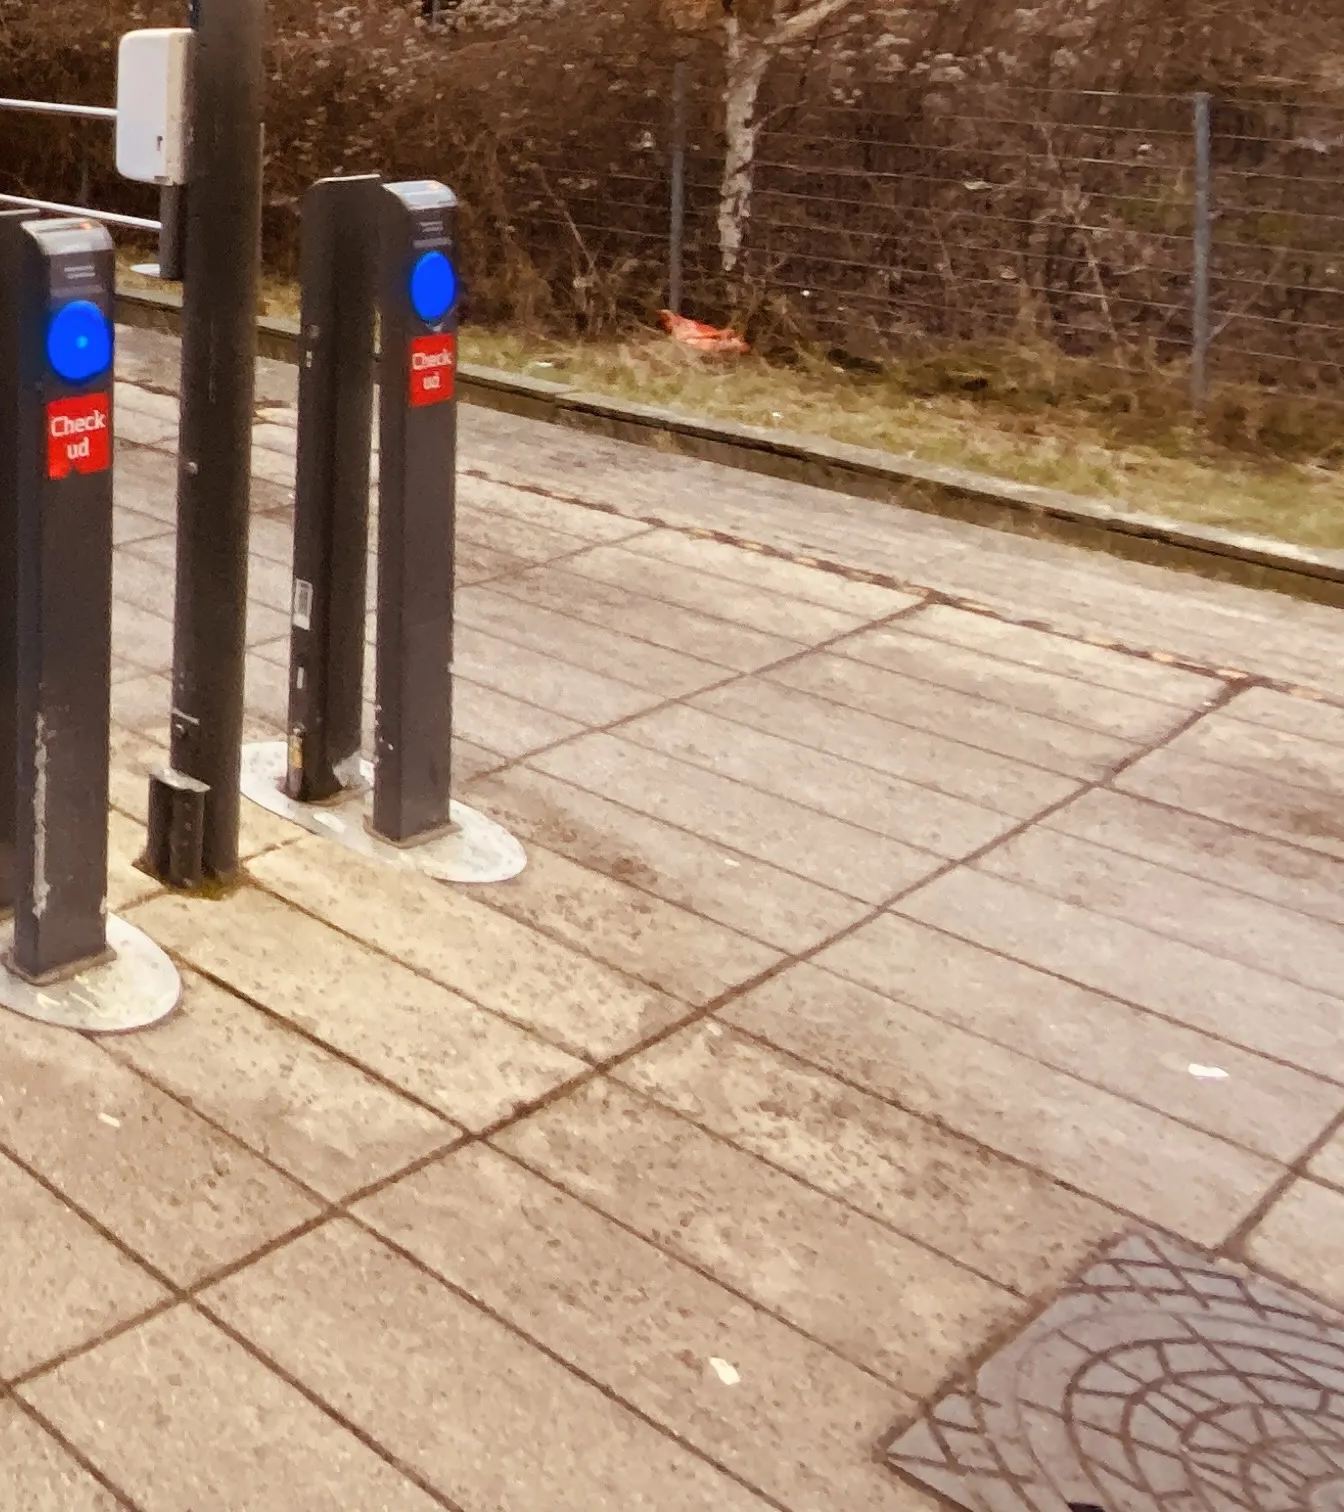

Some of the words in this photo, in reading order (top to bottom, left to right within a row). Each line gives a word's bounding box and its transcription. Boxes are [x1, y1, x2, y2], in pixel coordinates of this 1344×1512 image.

[412, 348, 453, 371] Check
[422, 372, 441, 390] ud
[50, 409, 107, 438] Check
[67, 437, 90, 459] ud
